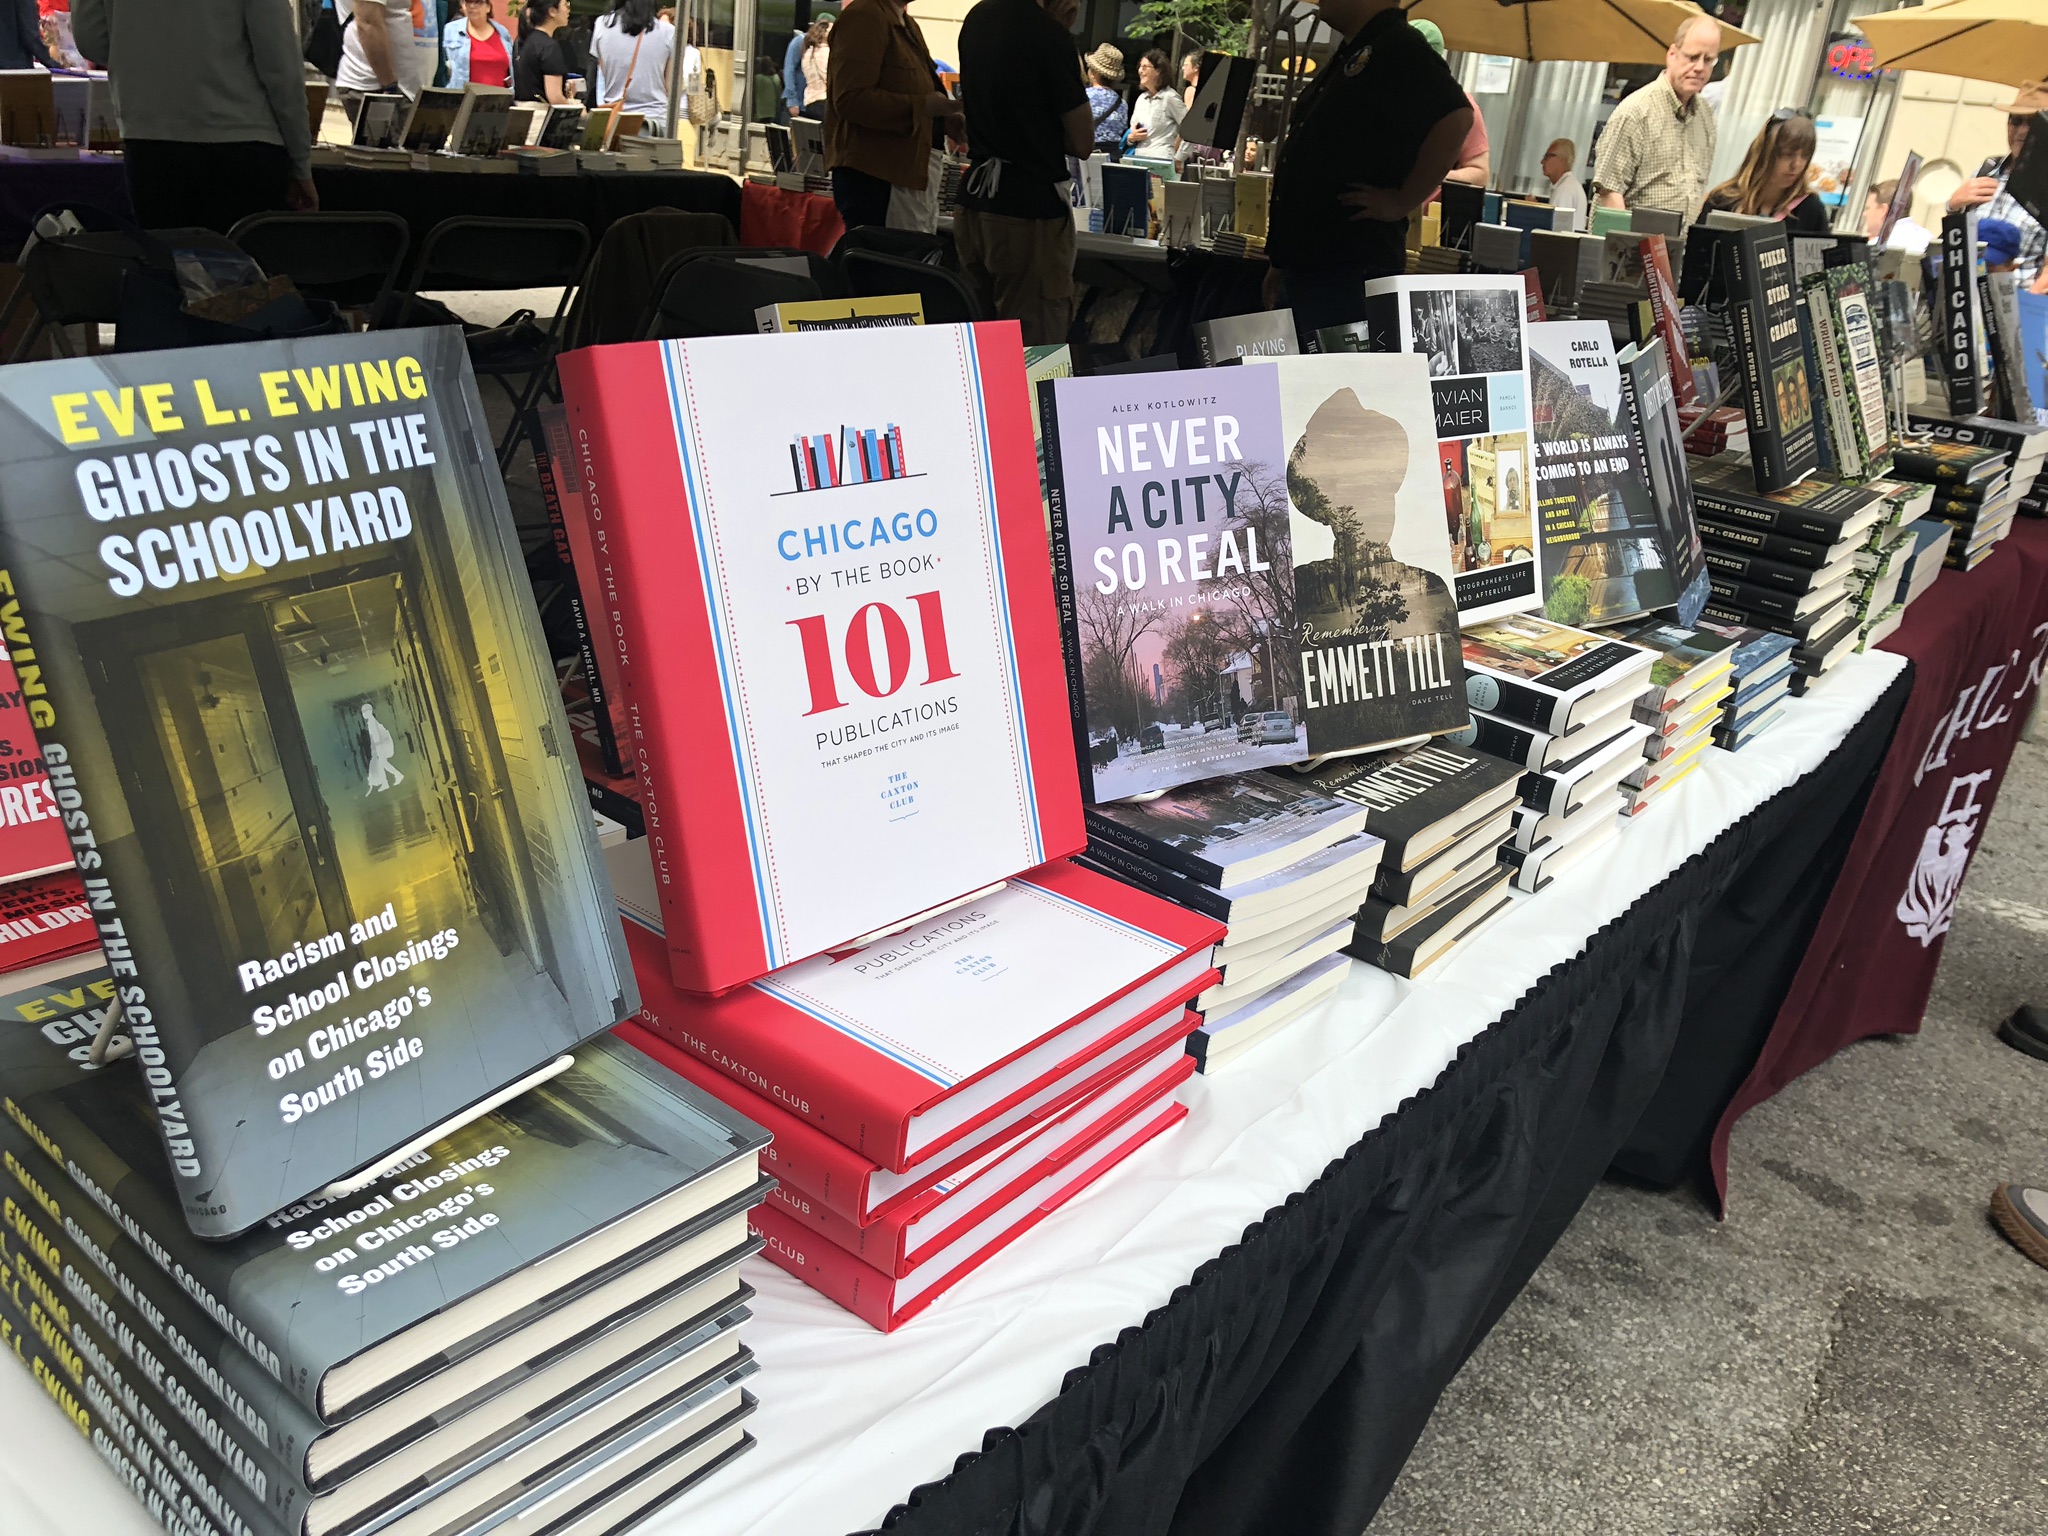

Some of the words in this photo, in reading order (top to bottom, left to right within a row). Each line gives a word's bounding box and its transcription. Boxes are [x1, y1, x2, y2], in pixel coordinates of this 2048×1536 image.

[1828, 44, 1875, 72] OPE
[1759, 248, 1787, 269] TINKER
[1642, 253, 1665, 323] SLAUGHTERHOUSE
[1766, 284, 1790, 305] EVERS
[1948, 228, 1970, 370] CHICAGO
[1236, 338, 1286, 356] PLAYING
[1571, 340, 1600, 352] CARLO
[1770, 317, 1798, 343] CHANCE
[1569, 356, 1609, 369] ROTELLA
[1740, 307, 1752, 344] TINKER
[1747, 352, 1757, 384] EVERS
[1752, 390, 1764, 427] CHANCE
[1819, 318, 1834, 365] WRIGLEY
[1827, 367, 1841, 398] FIELD
[51, 381, 185, 445] EVE
[194, 379, 251, 426] L.
[259, 356, 428, 419] EWING
[1112, 404, 1140, 413] ALEX
[1147, 396, 1217, 411] KOTLOWITZ
[1096, 414, 1243, 475] NEVER
[1542, 440, 1579, 457] WORLD
[1581, 440, 1591, 452] IS
[1594, 434, 1629, 451] ALWAYS
[74, 434, 291, 522] GHOSTS
[294, 425, 350, 486] IN
[350, 413, 436, 475] THE
[1535, 463, 1576, 481] COMING
[1577, 462, 1592, 476] TO
[1594, 459, 1609, 473] AN
[1610, 458, 1630, 472] END
[540, 472, 562, 525] DEATH
[553, 529, 572, 565] GAP
[1050, 488, 1063, 528] NEVER
[1107, 485, 1133, 534] A
[1141, 471, 1242, 529] CITY
[1697, 498, 1728, 512] EVERS
[1734, 507, 1772, 522] CHANCE
[100, 485, 413, 597] SCHOOLYARD
[578, 428, 602, 521] CHICAGO
[597, 530, 609, 555] BY
[604, 563, 618, 602] THE
[612, 610, 630, 666] BOOK
[777, 508, 938, 561] CHICAGO
[1055, 531, 1063, 540] A
[1722, 530, 1760, 545] CHANCE
[796, 574, 822, 595] BY
[831, 566, 871, 588] THE
[880, 553, 935, 579] BOOK
[1056, 543, 1068, 571] CITY
[1093, 542, 1147, 595] SO
[1157, 526, 1270, 585] REAL
[1512, 570, 1526, 580] LIFE
[1706, 555, 1743, 570] CHANCE
[1059, 575, 1069, 591] SO
[1116, 606, 1125, 617] A
[1130, 599, 1167, 615] WALK
[1170, 596, 1183, 607] IN
[1188, 586, 1252, 605] CHICAGO
[1458, 594, 1473, 603] AND
[1475, 584, 1512, 599] AFTERLIFE
[1061, 595, 1073, 624] REAL
[1705, 607, 1742, 622] CHANCE
[0, 569, 57, 730] EWING
[571, 598, 584, 630] DAVID
[592, 687, 602, 703] MD
[785, 590, 961, 717] 101
[1300, 618, 1390, 647] Remembering
[1301, 639, 1396, 710] EMMETT
[1402, 632, 1451, 692] TILL
[1070, 678, 1080, 718] CHICAGO
[1412, 696, 1432, 705] DAVE
[1436, 693, 1453, 702] TELL
[816, 696, 959, 750] PUBLICATIONS
[821, 757, 841, 769] THAT
[843, 748, 873, 763] SHAPED
[875, 743, 889, 753] THE
[891, 738, 907, 749] CITY
[909, 733, 924, 743] AND
[926, 730, 937, 739] ITS
[939, 722, 960, 735] IMAGE
[1202, 750, 1247, 763] AFTERWORD
[629, 702, 644, 740] THE
[639, 748, 661, 828] CAXTON
[655, 836, 671, 885] CLUB
[880, 780, 919, 800] CAXTON
[888, 771, 908, 783] THE
[1333, 761, 1442, 813] EMMETT
[1402, 745, 1479, 776] TILL
[43, 743, 102, 871] GHOSTS
[889, 795, 915, 810] CLUB
[1116, 829, 1149, 850] CHICAGO
[1096, 848, 1117, 863] WALK
[1125, 860, 1158, 882] CHICAGO
[85, 877, 117, 911] IN
[100, 917, 139, 978] THE
[238, 930, 347, 993] Racism
[350, 902, 398, 945] and
[854, 910, 987, 975] PUBLICATIONS
[895, 957, 922, 971] SHAPED
[954, 954, 975, 966] THE
[252, 971, 351, 1036] School
[353, 927, 460, 990] Closings
[956, 955, 993, 975] CAXTON
[972, 962, 997, 977] CLUB
[15, 978, 117, 1022] EVE
[267, 1046, 305, 1080] on
[307, 985, 433, 1060] Chicago's
[119, 985, 202, 1178] SCHOOLYARD
[279, 1063, 365, 1124] South
[366, 1035, 424, 1080] Side
[682, 1030, 707, 1054] THE
[711, 1049, 768, 1091] CAXTON
[772, 1084, 810, 1115] CLUB
[285, 1194, 395, 1251] School
[391, 1143, 511, 1202] Closings
[774, 1185, 810, 1215] CLUB
[313, 1246, 359, 1273] on
[355, 1182, 496, 1252] Chicago's
[66, 1160, 121, 1225] GHOSTS
[123, 1214, 143, 1244] IN
[142, 1232, 172, 1273] THE
[174, 1264, 282, 1382] SCHOOLYARD
[337, 1243, 436, 1295] South
[431, 1211, 501, 1249] Side
[768, 1235, 806, 1266] CLUB
[4, 1196, 61, 1277] EWING
[63, 1264, 117, 1338] GHOSTS
[116, 1321, 135, 1358] IN
[135, 1348, 165, 1391] THE
[166, 1376, 267, 1503] SCHOOLYARD
[30, 1302, 84, 1386] EWING
[64, 1217, 118, 1286] GHOSTS
[119, 1273, 136, 1305] IN
[137, 1294, 165, 1334] THE
[166, 1325, 269, 1448] SCHOOLYARD
[33, 1355, 91, 1438] EWING
[93, 1427, 146, 1502] GHOSTS
